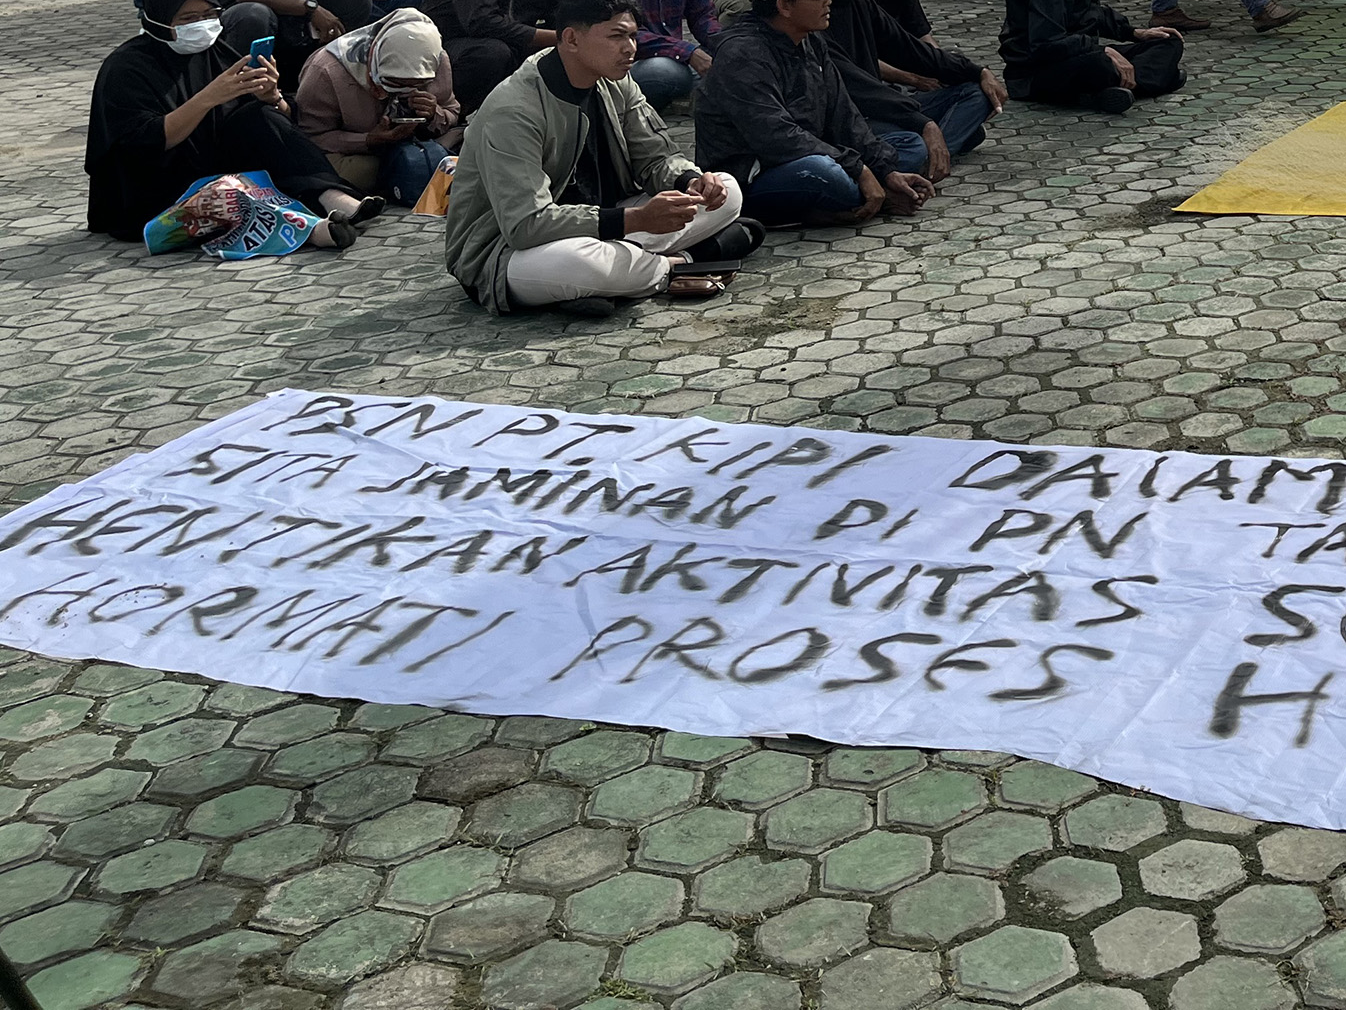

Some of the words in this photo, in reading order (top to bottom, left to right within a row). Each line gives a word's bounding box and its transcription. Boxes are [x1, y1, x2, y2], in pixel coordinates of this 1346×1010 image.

[163, 443, 360, 489] SITA
[357, 461, 777, 530] JAMINAN
[812, 498, 919, 541] DI
[968, 508, 1149, 559] PN
[633, 427, 894, 489] KIPI
[0, 495, 589, 575] HENTIKAN
[562, 541, 1160, 628] AKTIVITAS
[0, 571, 516, 673] HORMATI
[548, 613, 1115, 701] PROSES
